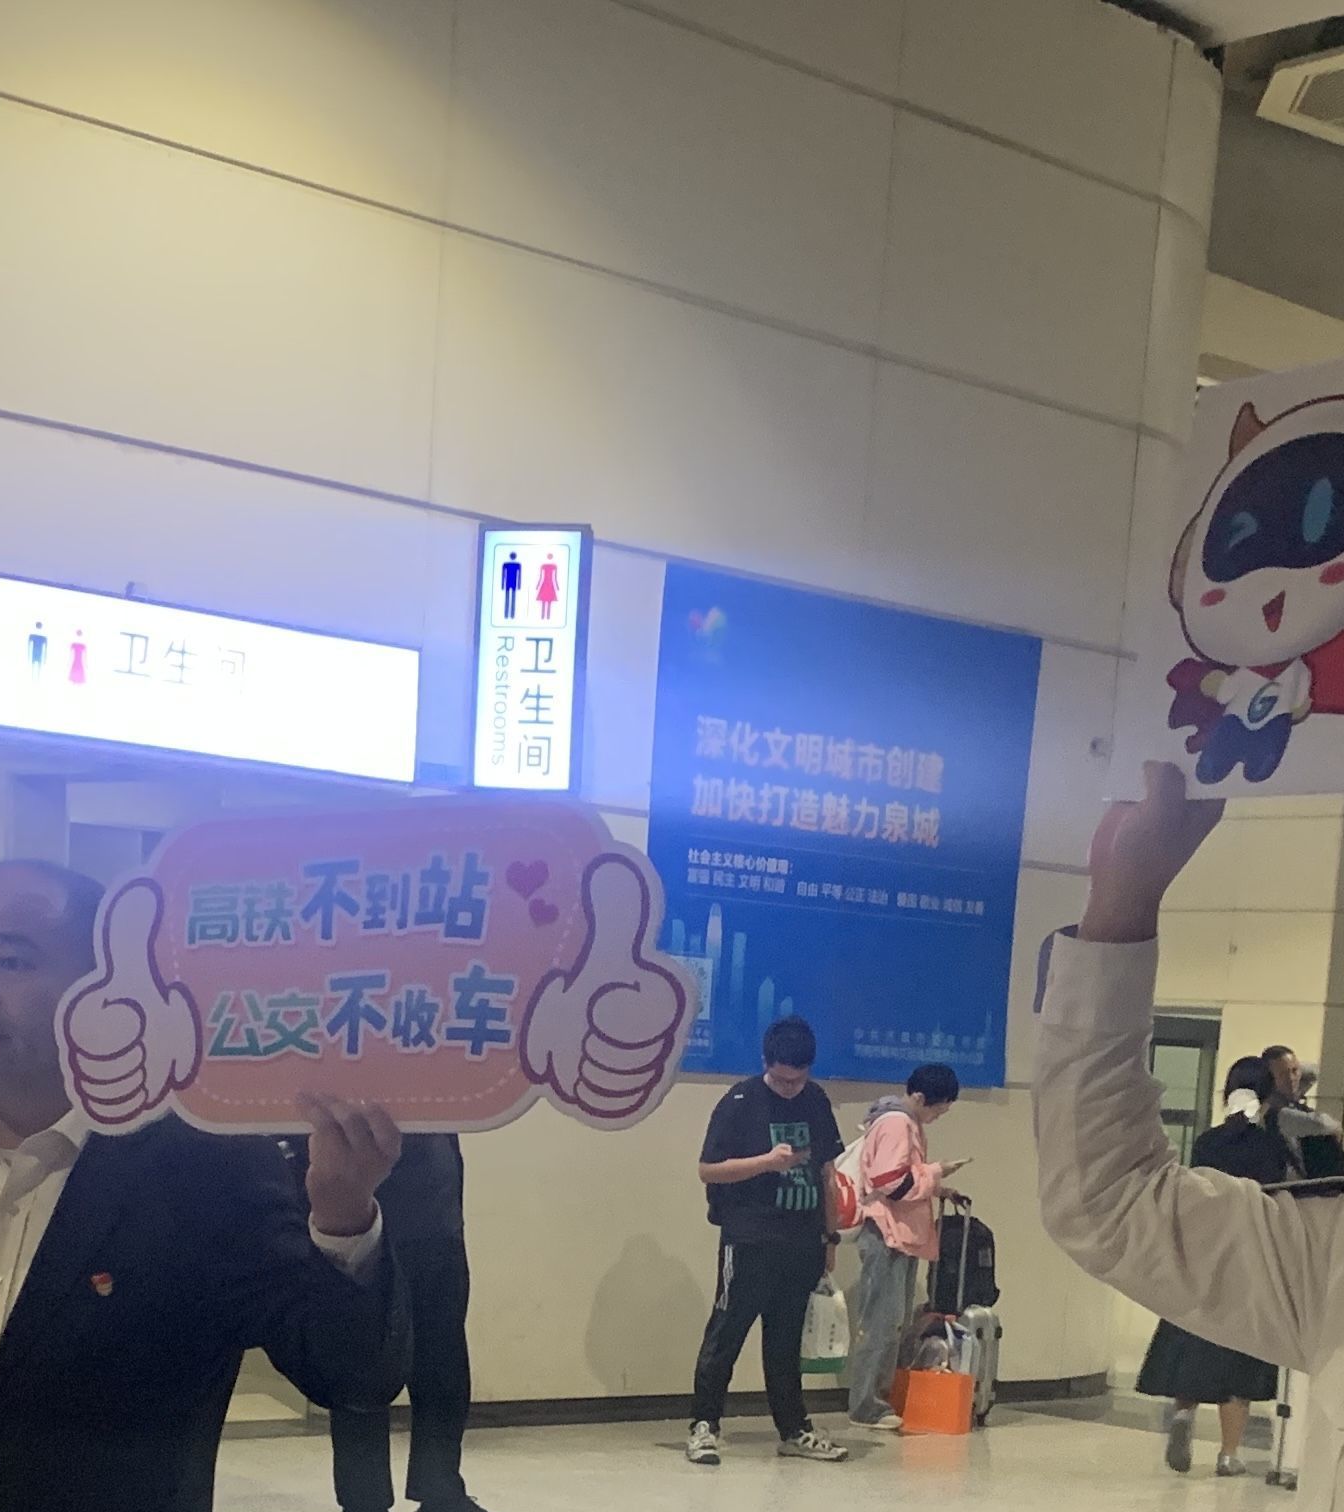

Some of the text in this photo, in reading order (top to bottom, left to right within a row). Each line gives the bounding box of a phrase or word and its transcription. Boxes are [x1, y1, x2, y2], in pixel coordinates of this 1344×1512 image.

[113, 631, 246, 695] 卫生间
[491, 635, 515, 766] Restrooms
[518, 637, 557, 776] 卫生间
[695, 714, 945, 795] 深化文明城市创建
[690, 774, 941, 849] 加快打造魅力泉城
[187, 851, 490, 944] 高铁不到站
[208, 965, 517, 1058] 公交不收车
